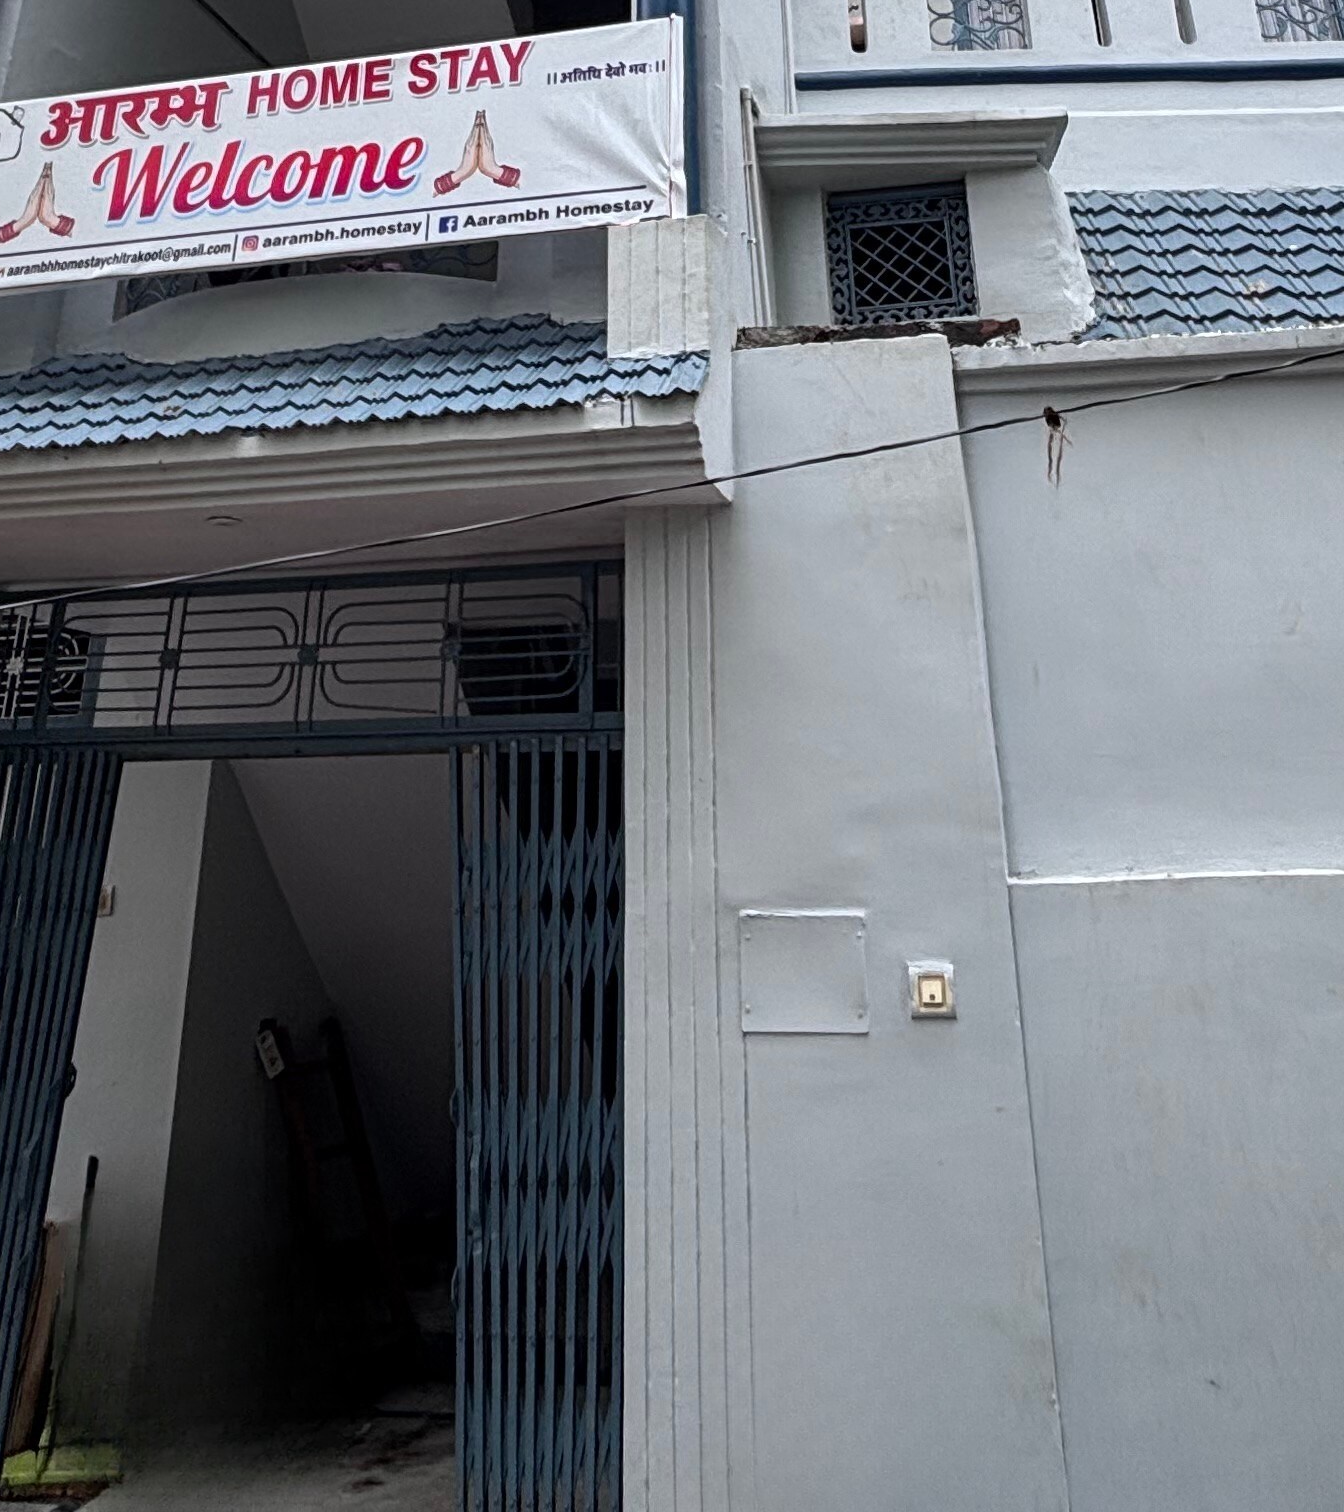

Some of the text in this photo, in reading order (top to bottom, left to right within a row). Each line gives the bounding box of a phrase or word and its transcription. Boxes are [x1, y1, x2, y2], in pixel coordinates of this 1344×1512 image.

[40, 40, 534, 148] आरम्भ HOME STAY
[91, 135, 426, 222] Welcome
[463, 197, 655, 228] Aarambh Homestay
[262, 219, 422, 249] aarambh.homestay
[7, 243, 231, 277] aarambhhomestaychitrakoot@gmail.com
